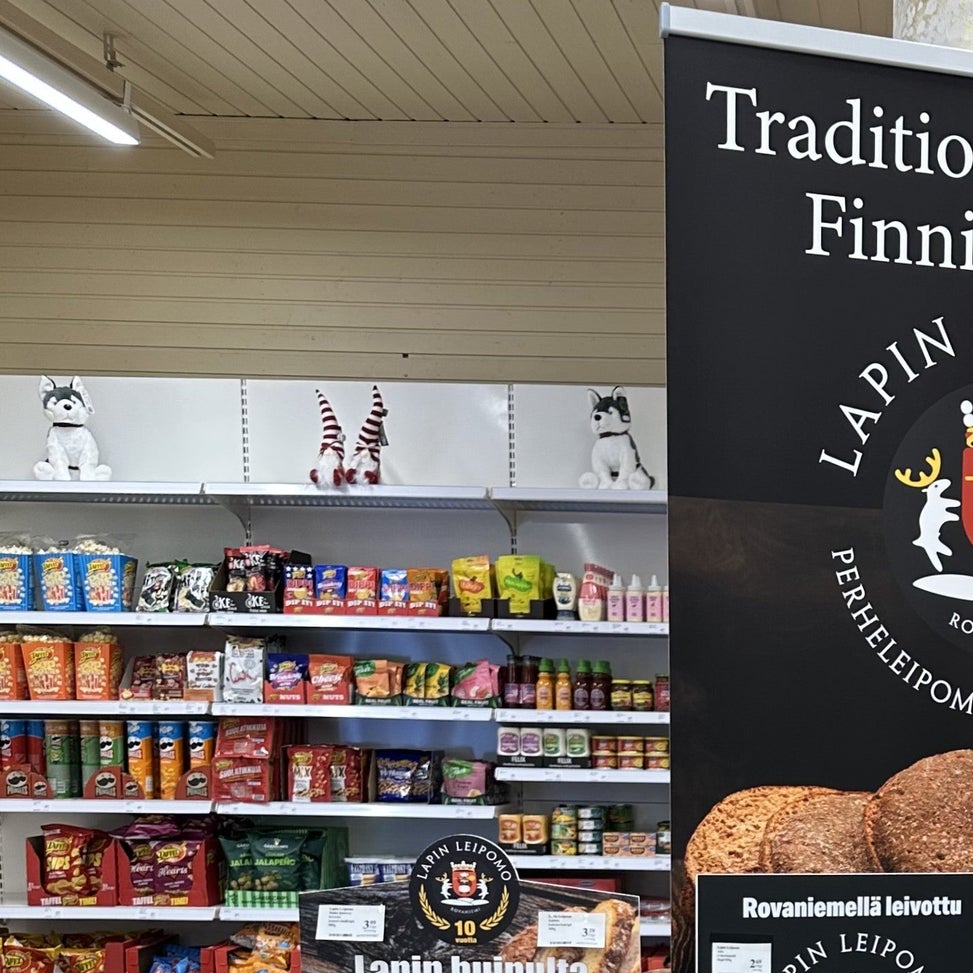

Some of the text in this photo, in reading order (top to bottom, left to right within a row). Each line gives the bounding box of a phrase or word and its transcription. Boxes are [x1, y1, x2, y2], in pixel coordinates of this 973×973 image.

[818, 315, 957, 478] LAPIN
[254, 857, 296, 866] JALAPEÑO
[416, 841, 512, 881] LAPIN LEIPOMO
[742, 895, 962, 921] Rovaniemellä leivottu
[362, 920, 369, 930] 3
[454, 919, 476, 936] 10
[582, 927, 588, 937] 3
[749, 958, 756, 969] 2
